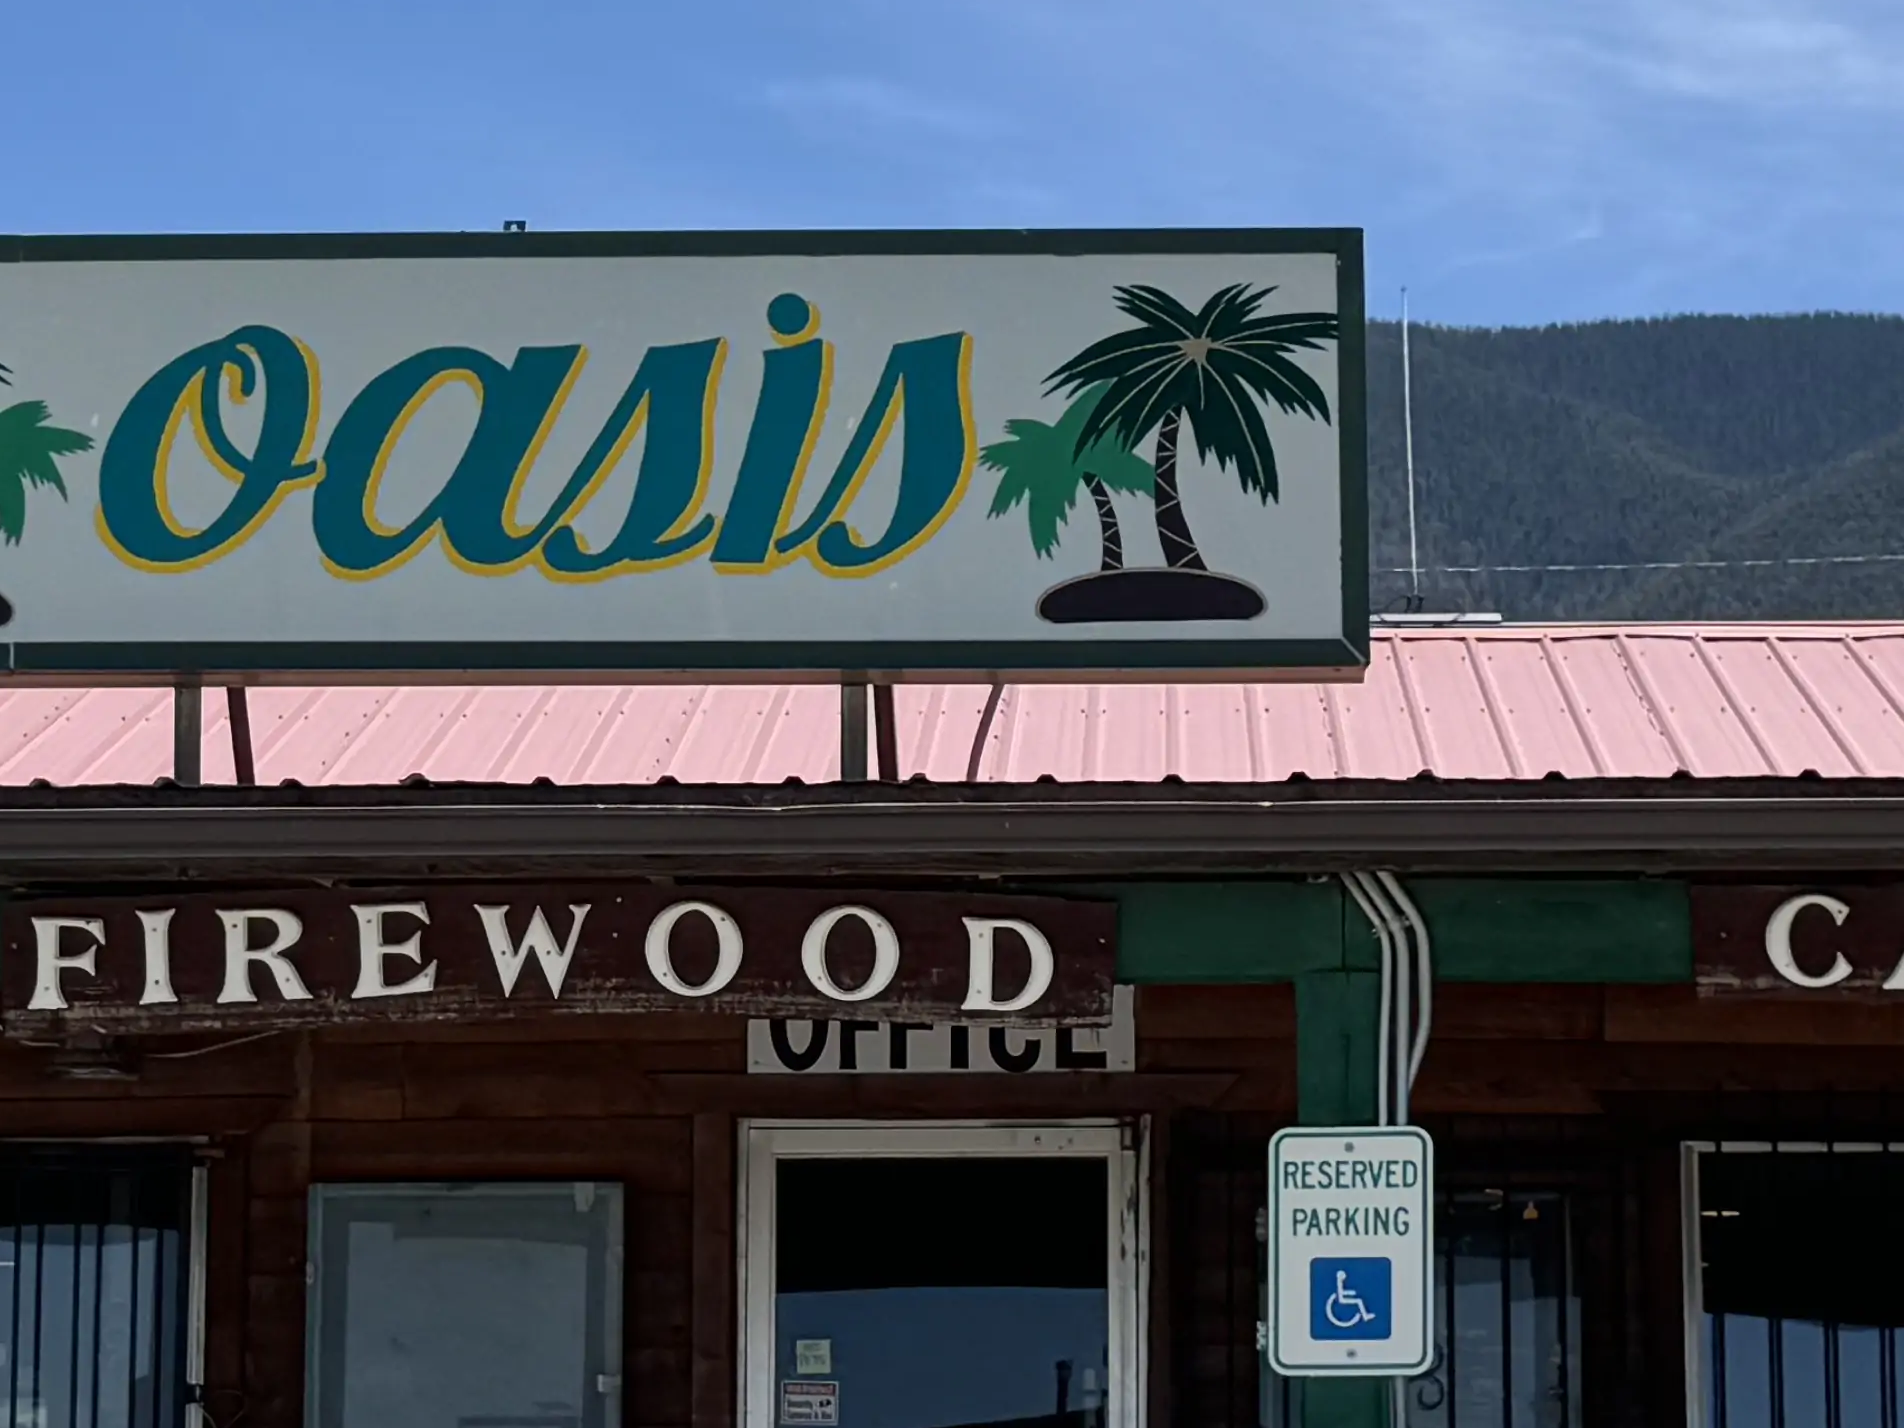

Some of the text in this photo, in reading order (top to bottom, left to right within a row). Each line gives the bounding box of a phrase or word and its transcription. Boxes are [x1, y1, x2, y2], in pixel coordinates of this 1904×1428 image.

[96, 293, 976, 583] oasis
[28, 900, 1054, 1013] FIREWOOD
[1284, 1160, 1417, 1189] RESERVED
[1292, 1207, 1410, 1236] PARKING
